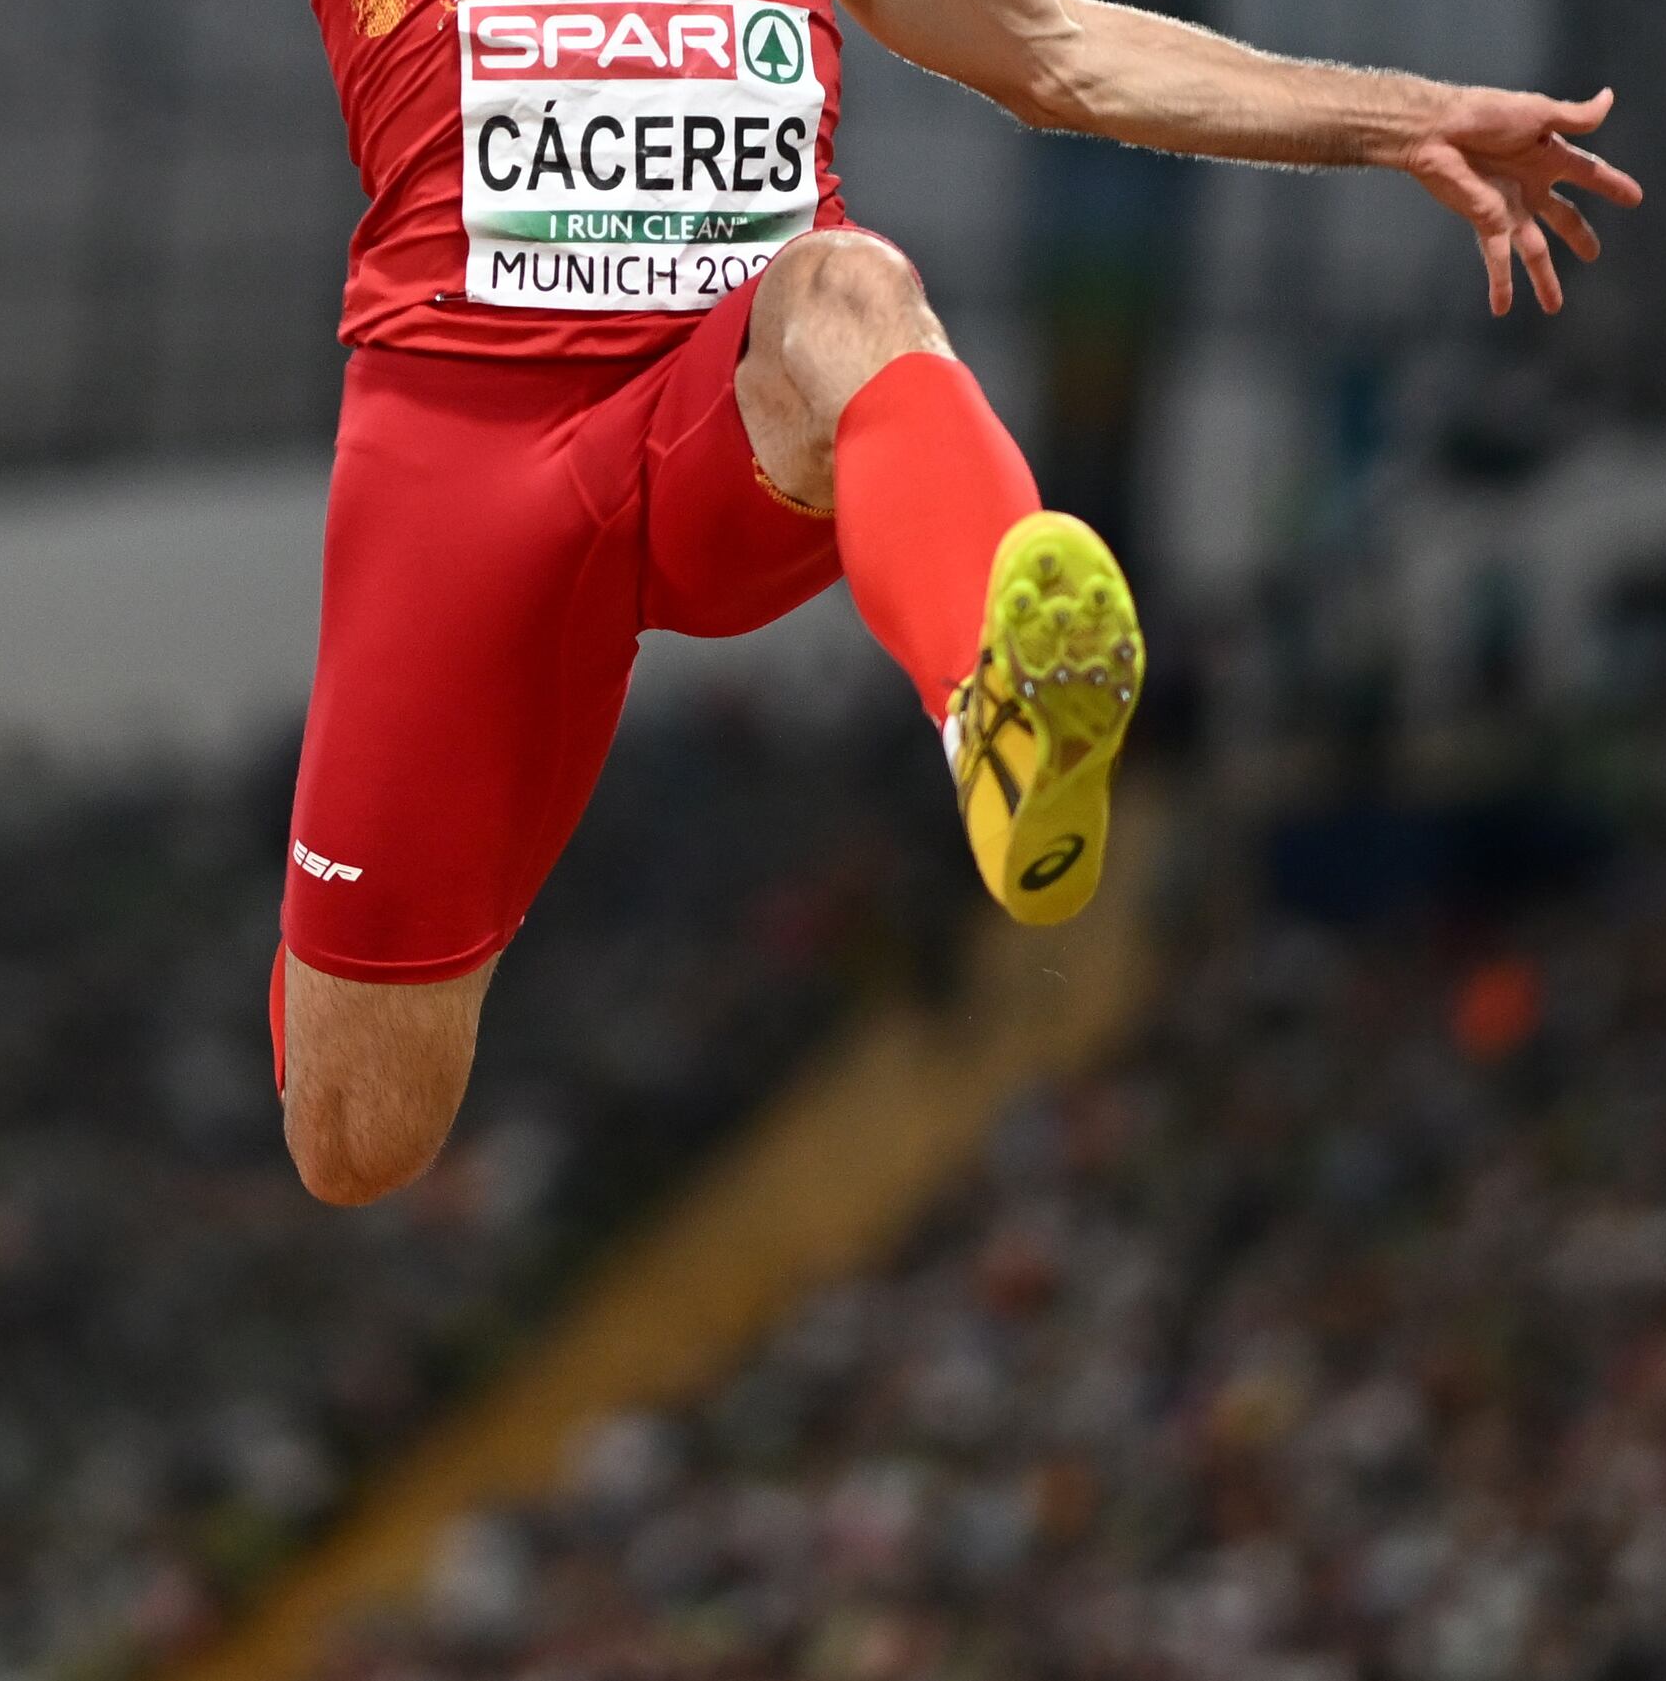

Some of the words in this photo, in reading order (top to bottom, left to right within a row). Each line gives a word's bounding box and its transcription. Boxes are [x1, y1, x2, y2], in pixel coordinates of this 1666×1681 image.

[476, 13, 733, 69] SPAR
[477, 100, 807, 193] CÁCERES
[549, 214, 557, 239] I
[566, 214, 633, 239] RUN
[491, 250, 678, 296] MUNICH
[293, 838, 364, 882] ESP
